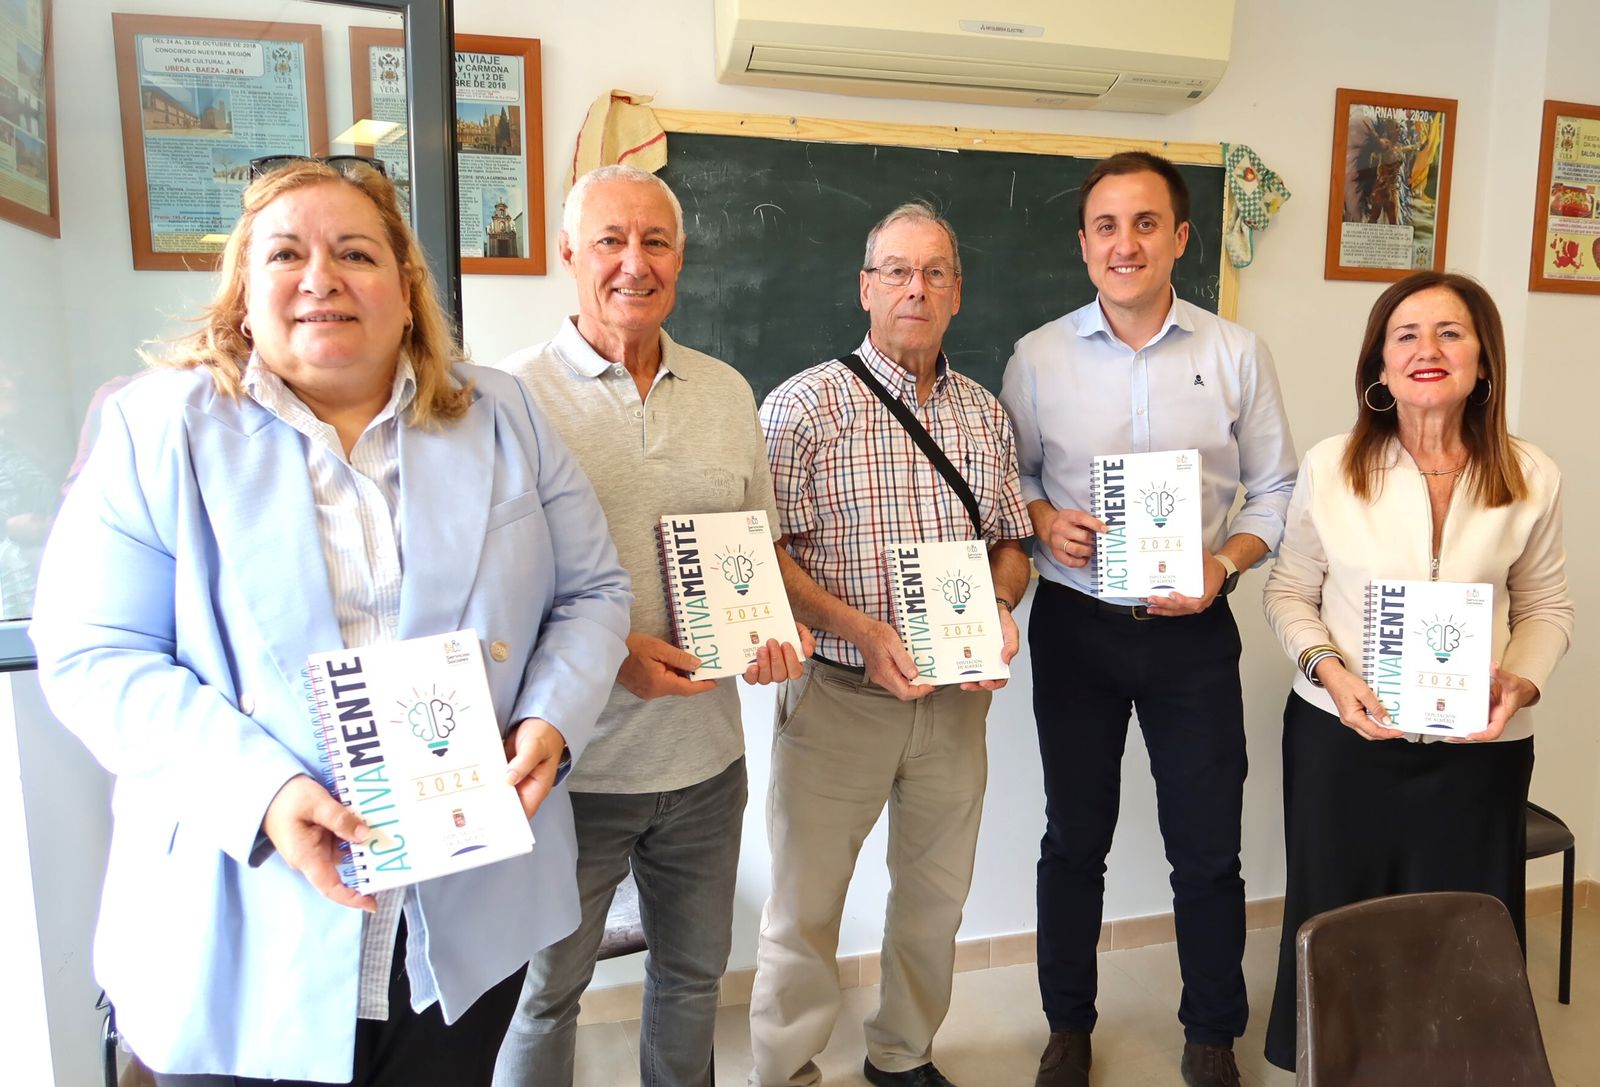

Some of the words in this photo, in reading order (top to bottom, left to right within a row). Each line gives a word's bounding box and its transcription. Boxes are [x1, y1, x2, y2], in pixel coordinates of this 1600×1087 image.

[469, 55, 500, 65] VIAJE
[465, 65, 509, 73] CARMONA
[1363, 105, 1408, 121] CARNAVAL
[1410, 110, 1428, 122] 2020
[1103, 459, 1128, 590] ACTIVAMENTE
[1141, 539, 1181, 550] 2024
[672, 519, 722, 670] ACTIVAMENTE
[726, 605, 771, 622] 2024
[898, 548, 937, 678] ACTIVAMENTE
[944, 625, 983, 636] 2024
[1418, 674, 1465, 687] 2024
[326, 656, 412, 872] ACTIVAMENTE
[416, 770, 480, 797] 2024
